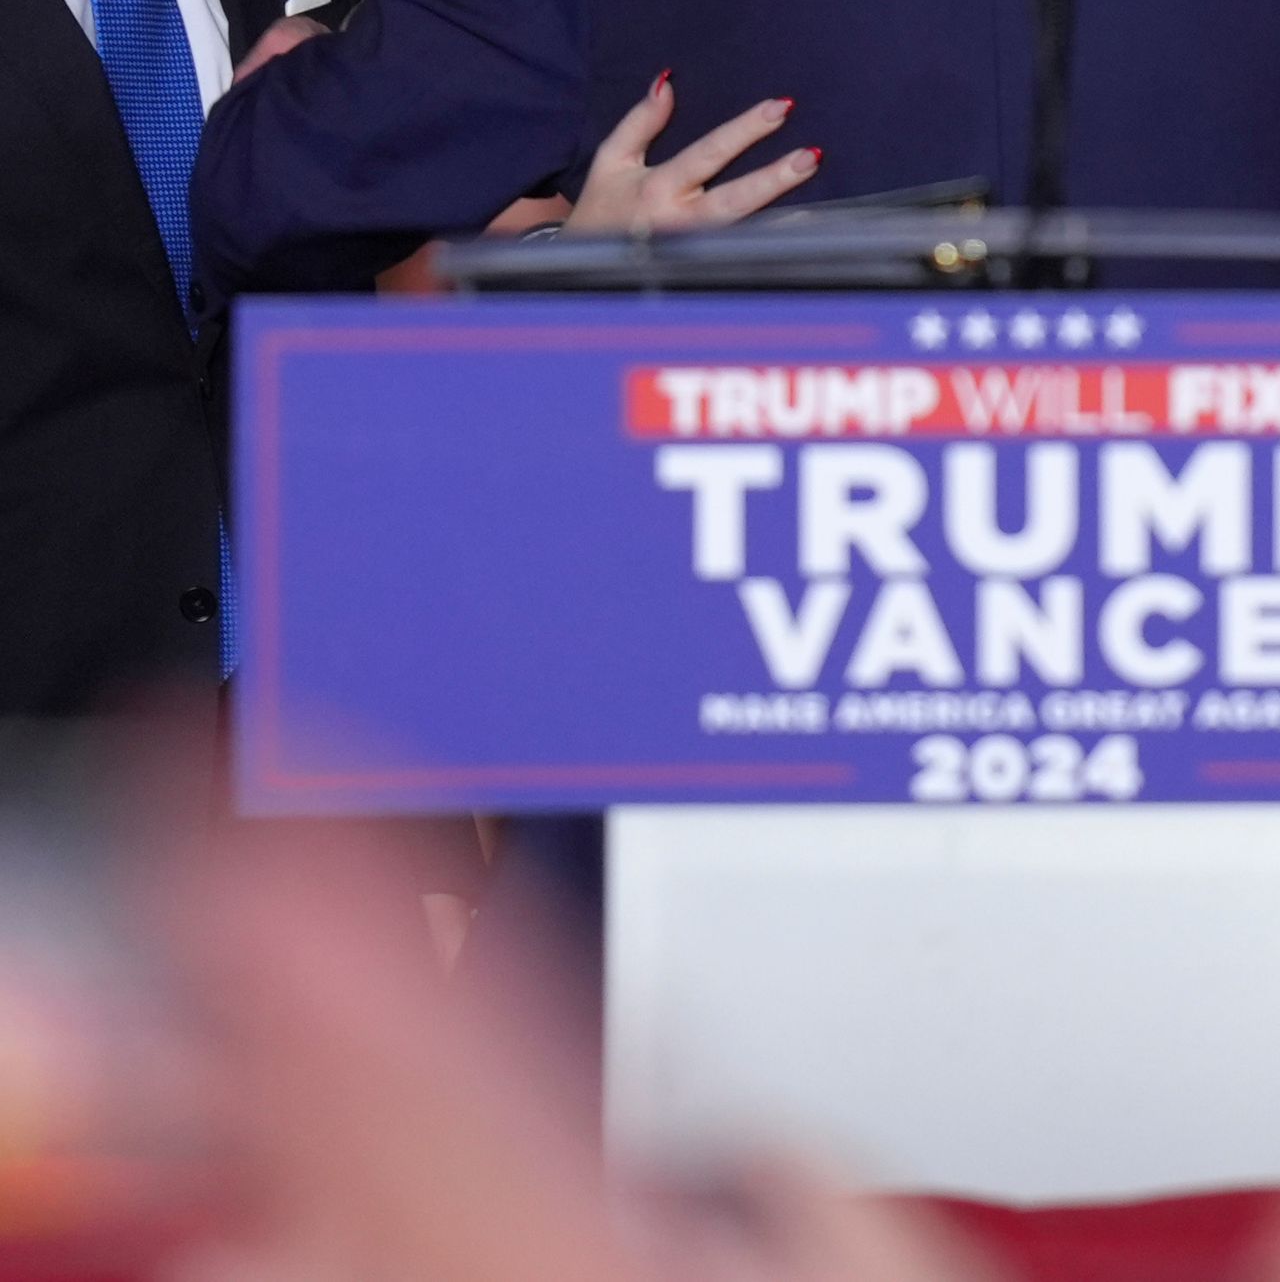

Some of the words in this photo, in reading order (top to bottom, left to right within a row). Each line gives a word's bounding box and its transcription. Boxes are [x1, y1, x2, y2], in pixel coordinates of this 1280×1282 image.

[657, 369, 940, 435] TRUMP
[951, 371, 1154, 434] WILL
[700, 693, 829, 733] MAKE
[835, 692, 1037, 732] AMERICA
[1041, 691, 1189, 731] GREAT
[910, 733, 1145, 802] 2024
